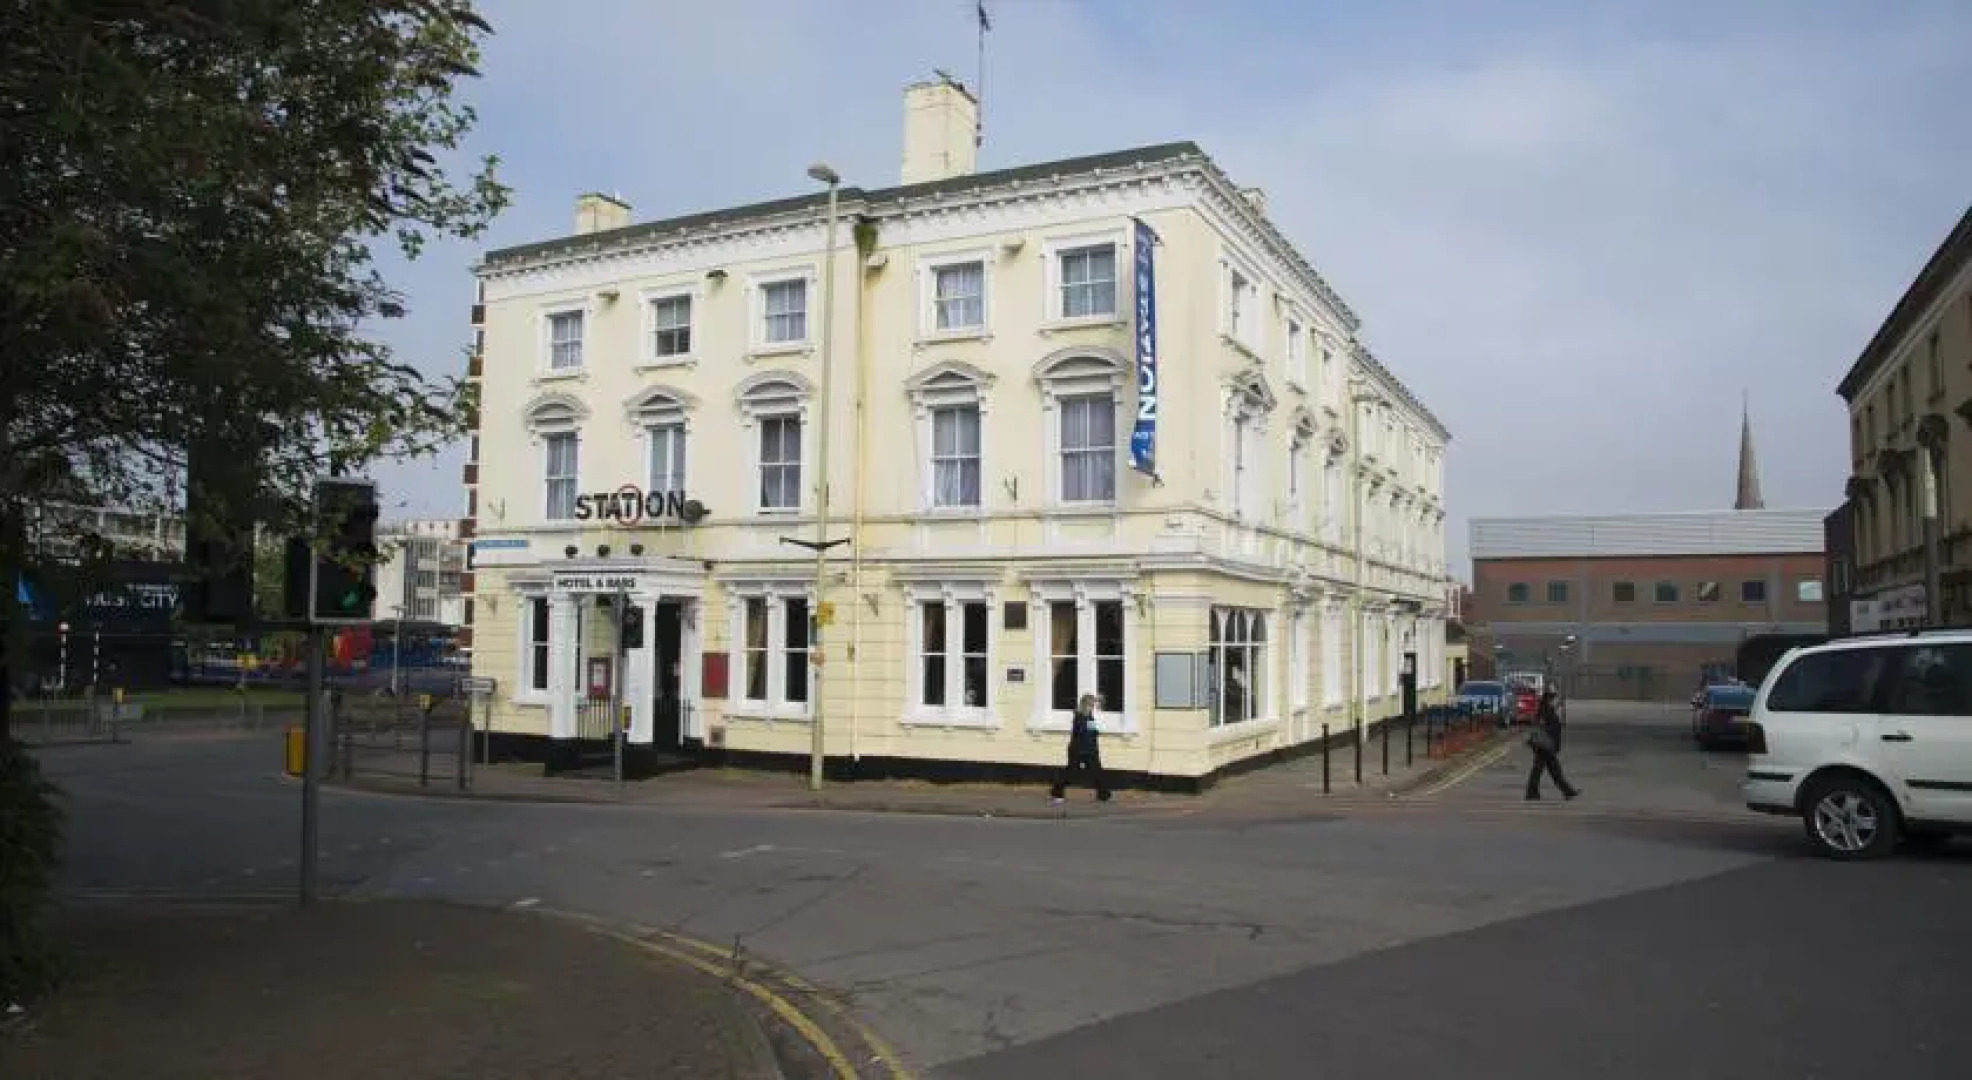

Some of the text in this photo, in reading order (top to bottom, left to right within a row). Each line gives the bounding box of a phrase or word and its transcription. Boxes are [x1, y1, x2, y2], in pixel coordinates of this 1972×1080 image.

[575, 487, 685, 521] STATION
[557, 577, 592, 588] HOTEL
[606, 576, 636, 588] BARS
